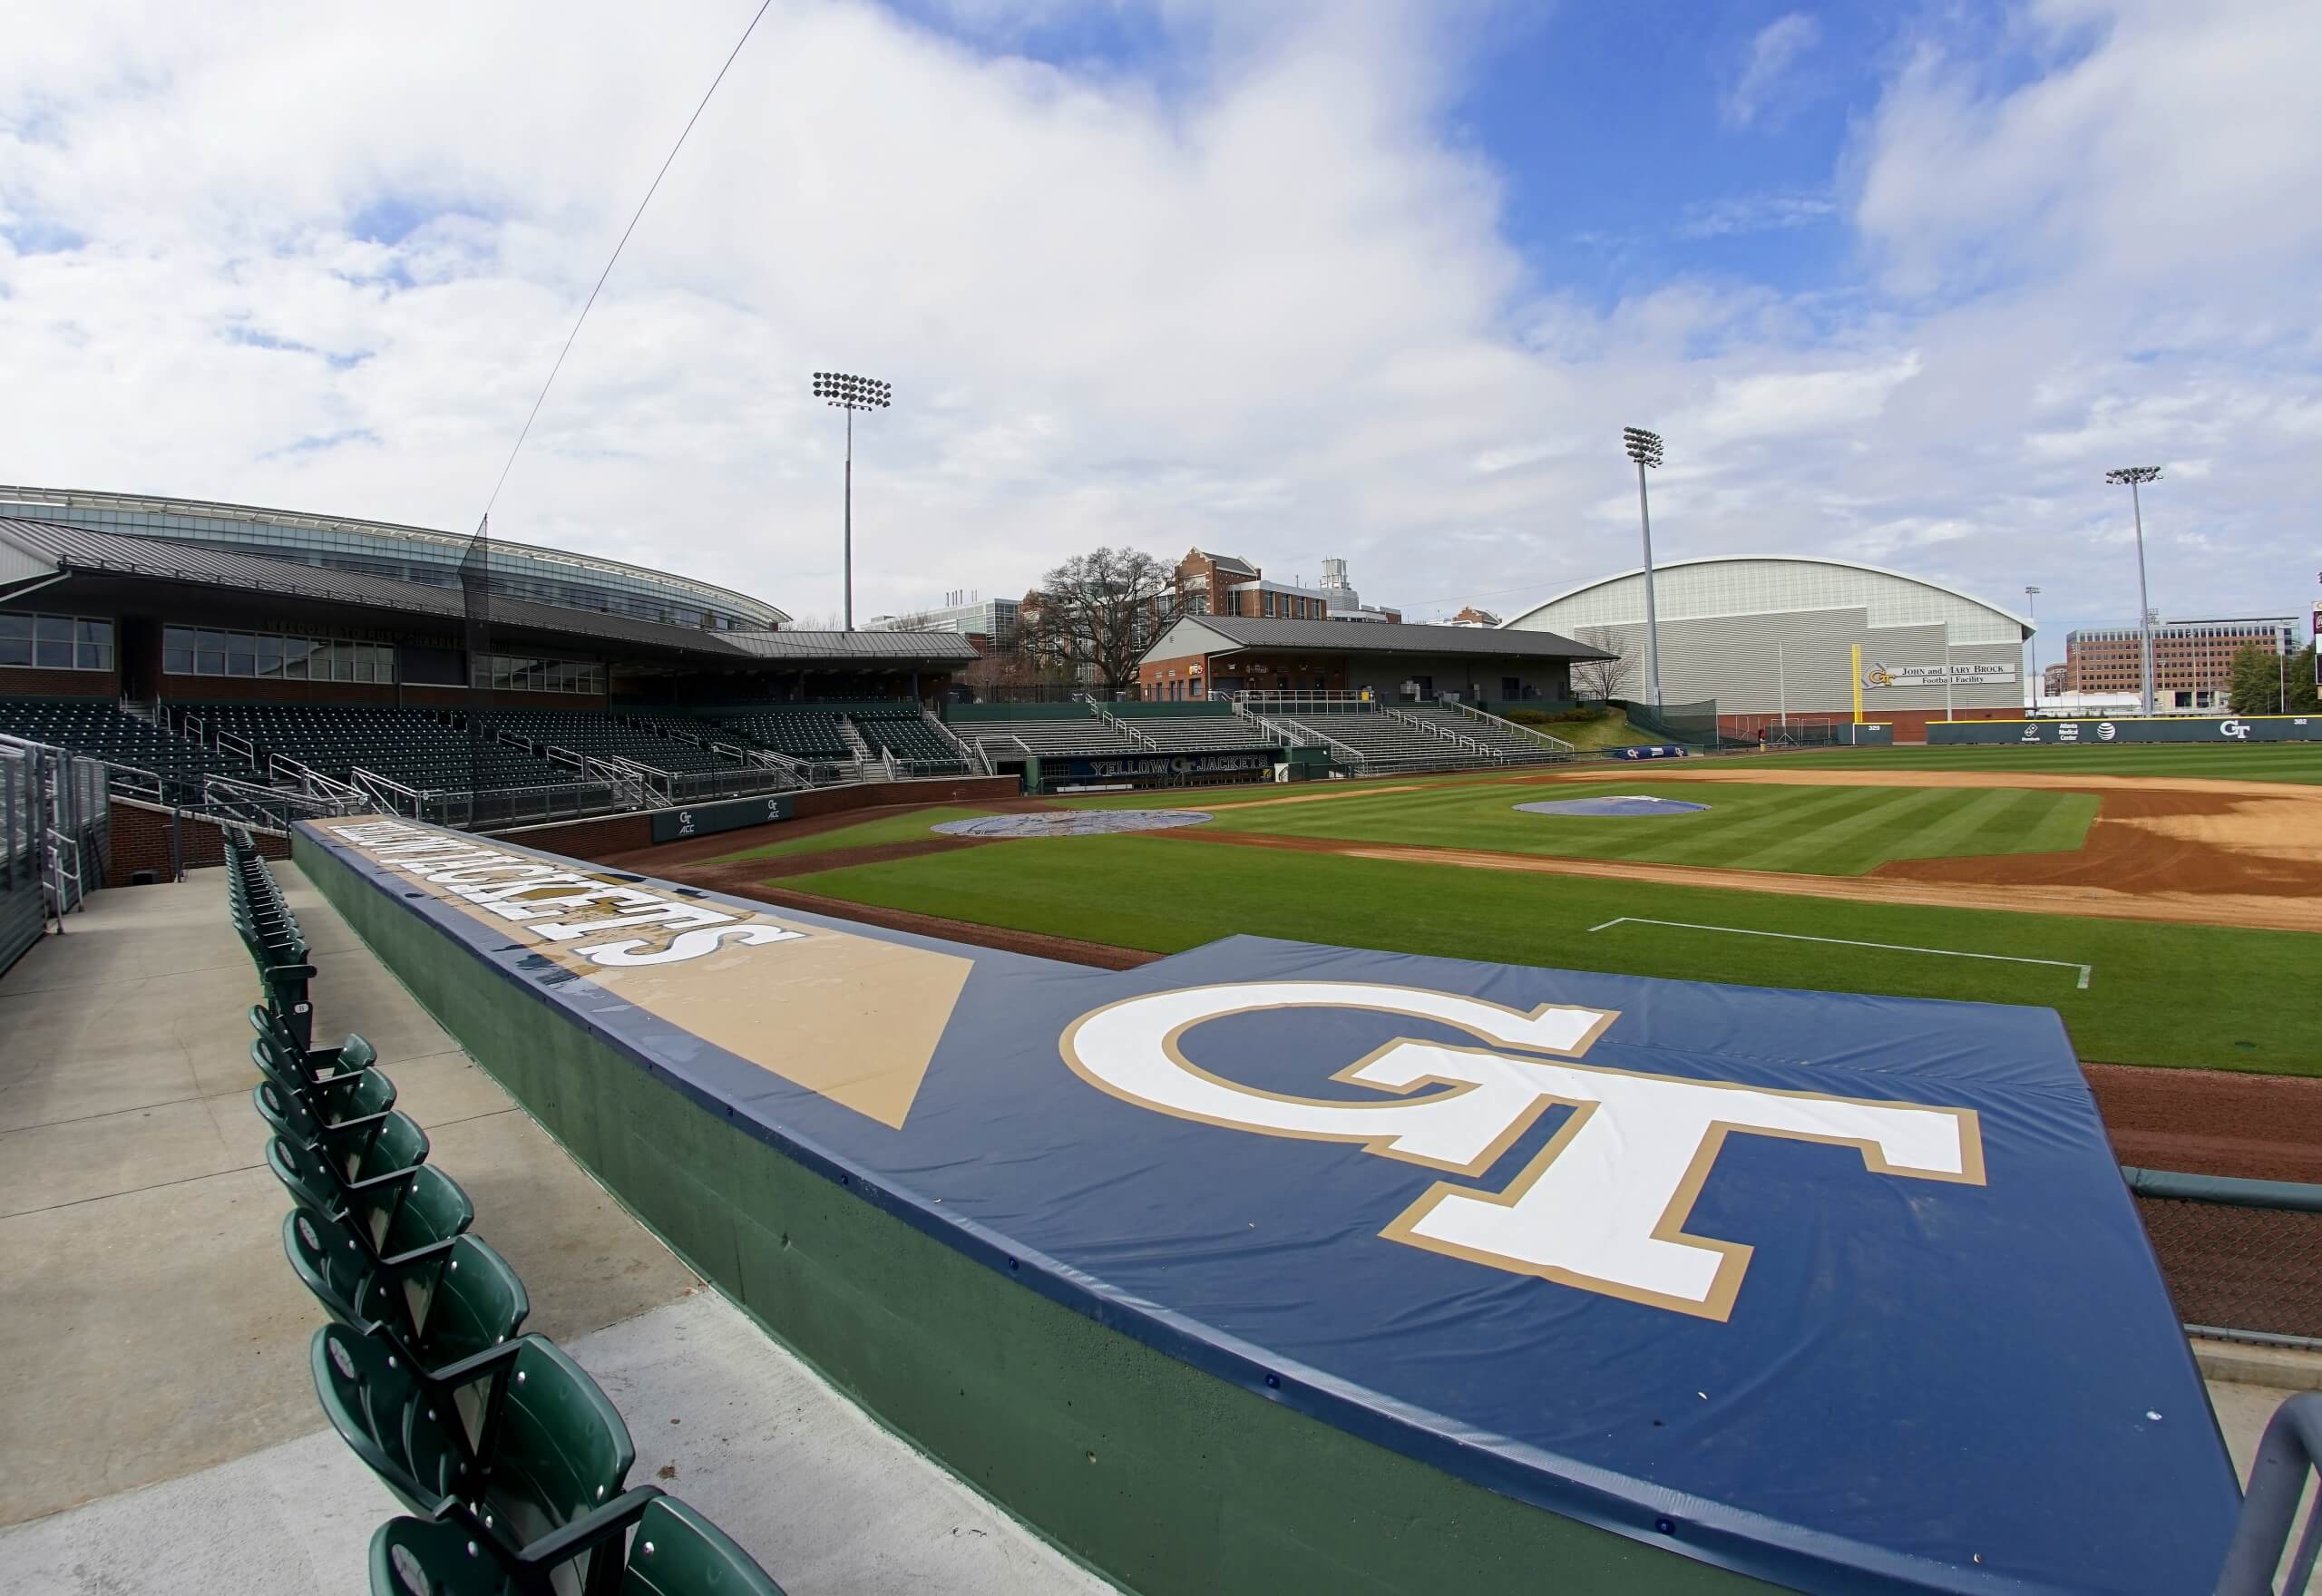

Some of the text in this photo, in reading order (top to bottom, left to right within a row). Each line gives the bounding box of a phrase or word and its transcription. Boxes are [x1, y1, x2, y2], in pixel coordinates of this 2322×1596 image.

[1974, 665, 2004, 673] BROCK
[1956, 676, 1984, 684] Facility
[2220, 719, 2250, 739] GT
[1089, 758, 1170, 776] YELLOW
[1196, 754, 1269, 771] JACKETS
[679, 811, 692, 824] GT
[767, 810, 780, 819] ACC
[678, 823, 696, 834] ACC
[1058, 980, 1986, 1322] GT
